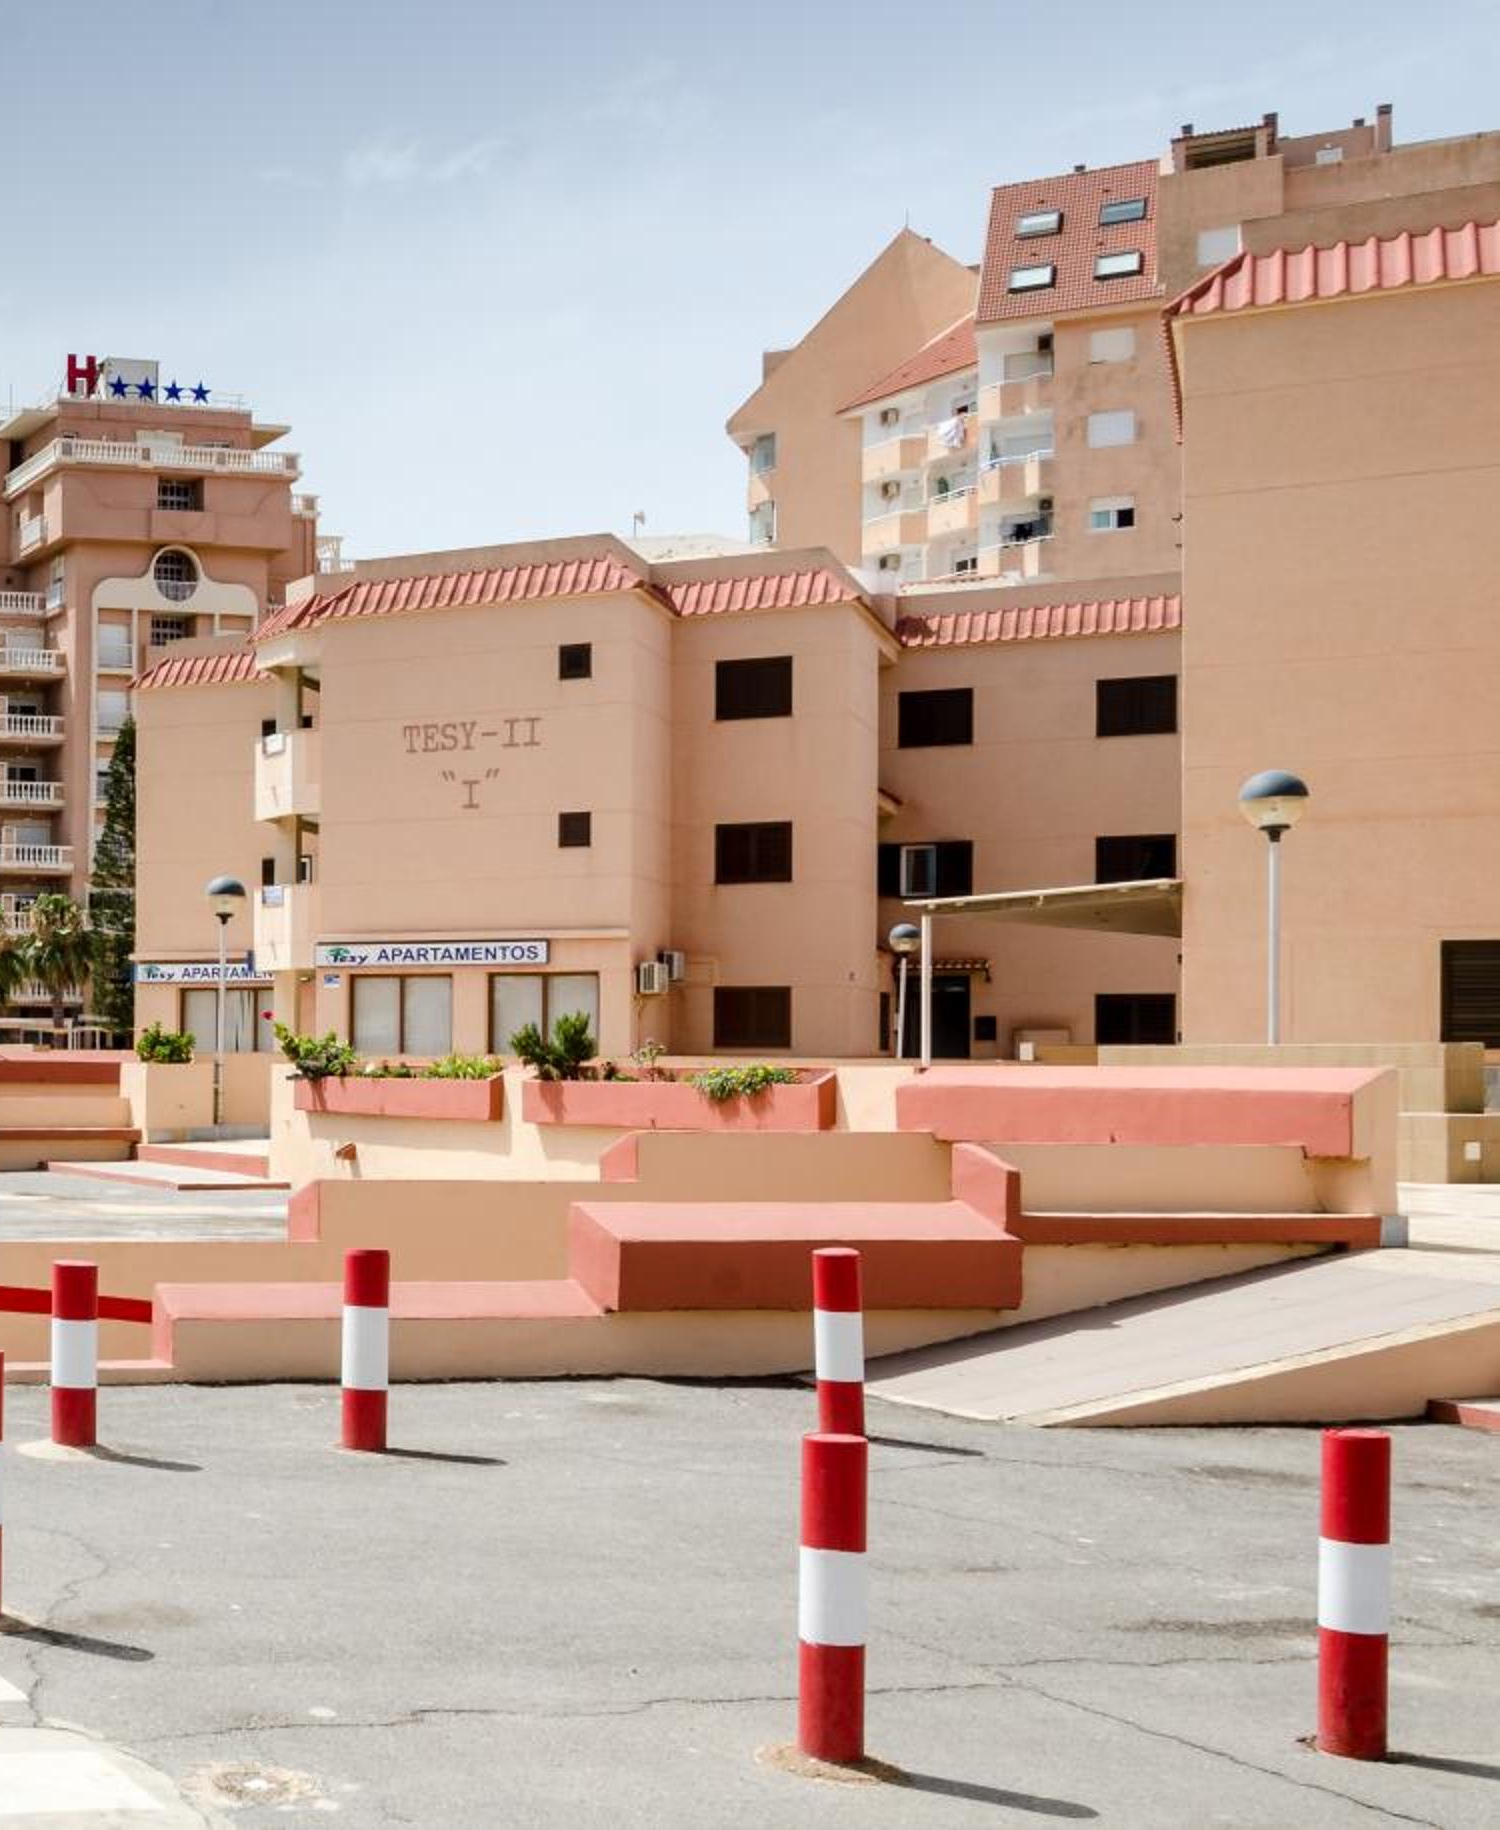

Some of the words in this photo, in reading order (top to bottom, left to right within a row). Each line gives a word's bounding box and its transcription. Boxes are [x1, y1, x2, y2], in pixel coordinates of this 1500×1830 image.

[67, 353, 97, 398] H
[403, 717, 543, 753] TESY-II
[377, 945, 539, 962] APARTAMENTOS
